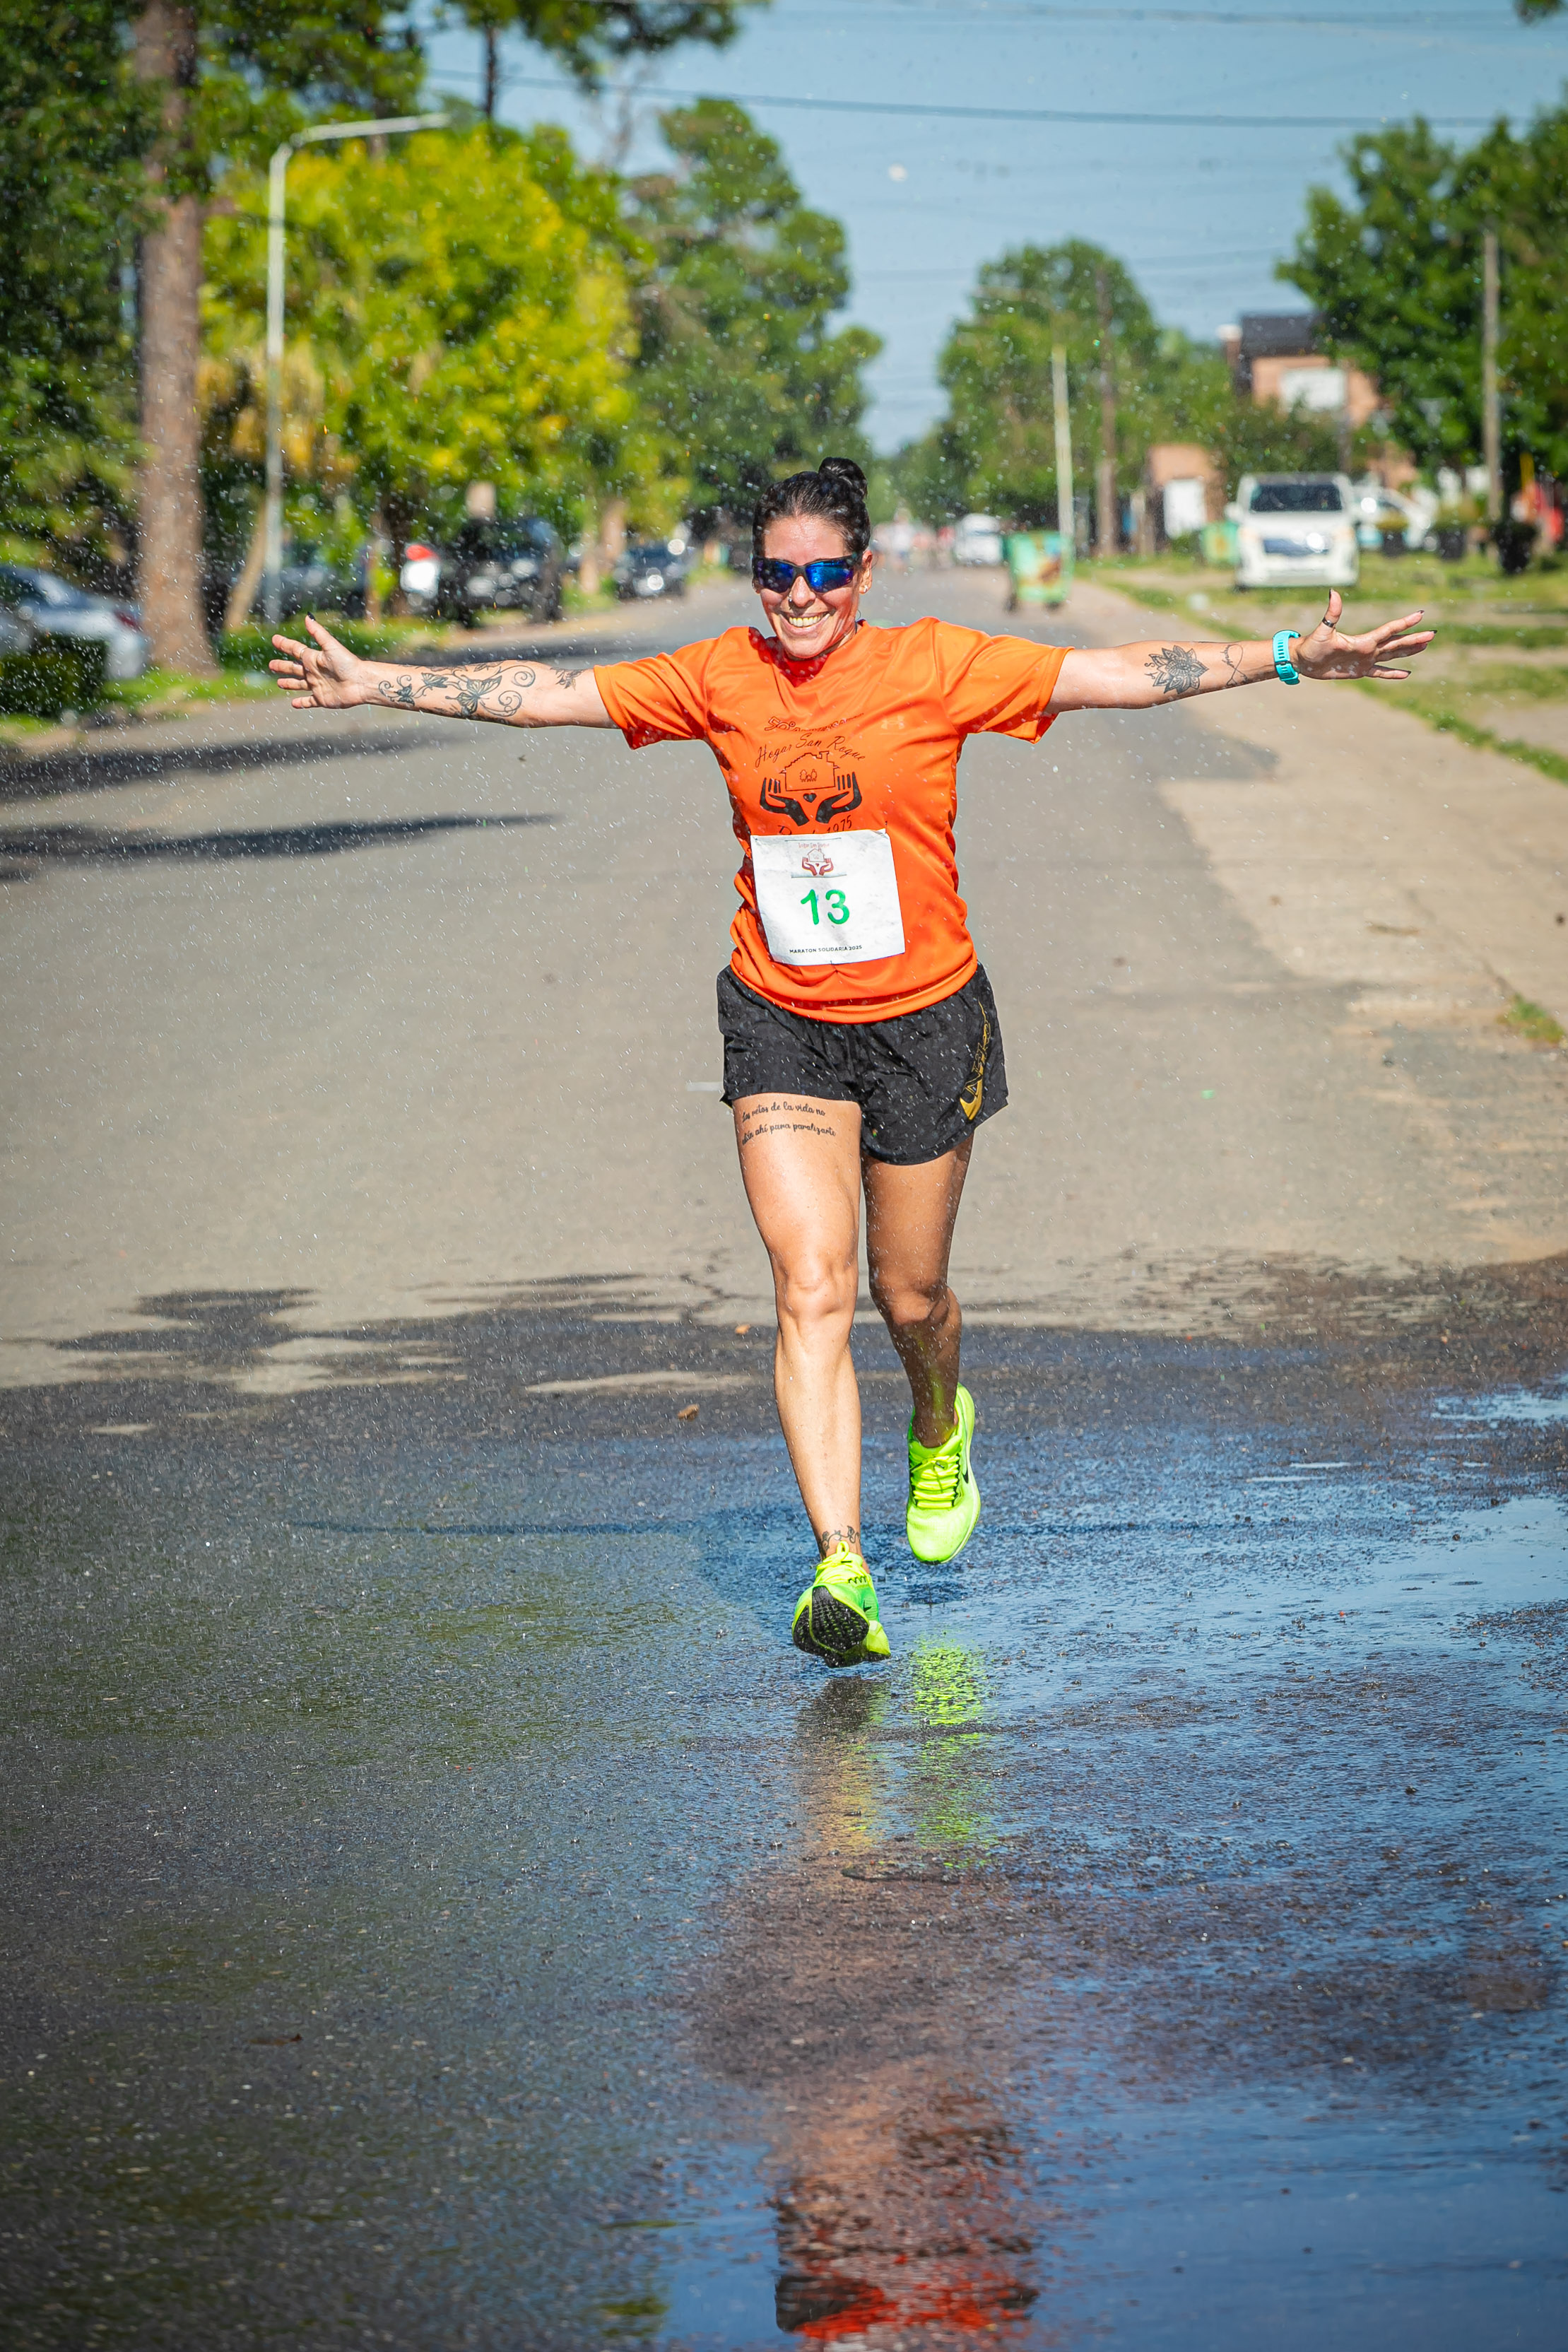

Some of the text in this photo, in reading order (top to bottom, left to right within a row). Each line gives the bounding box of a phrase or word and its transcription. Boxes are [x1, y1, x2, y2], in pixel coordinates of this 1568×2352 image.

[755, 732, 866, 768] Hogar San Roque
[801, 889, 850, 925] 13
[771, 1102, 782, 1111] de
[783, 1101, 794, 1111] la
[795, 1103, 815, 1114] vida
[770, 1124, 791, 1135] para
[793, 1122, 837, 1137] paralizarte
